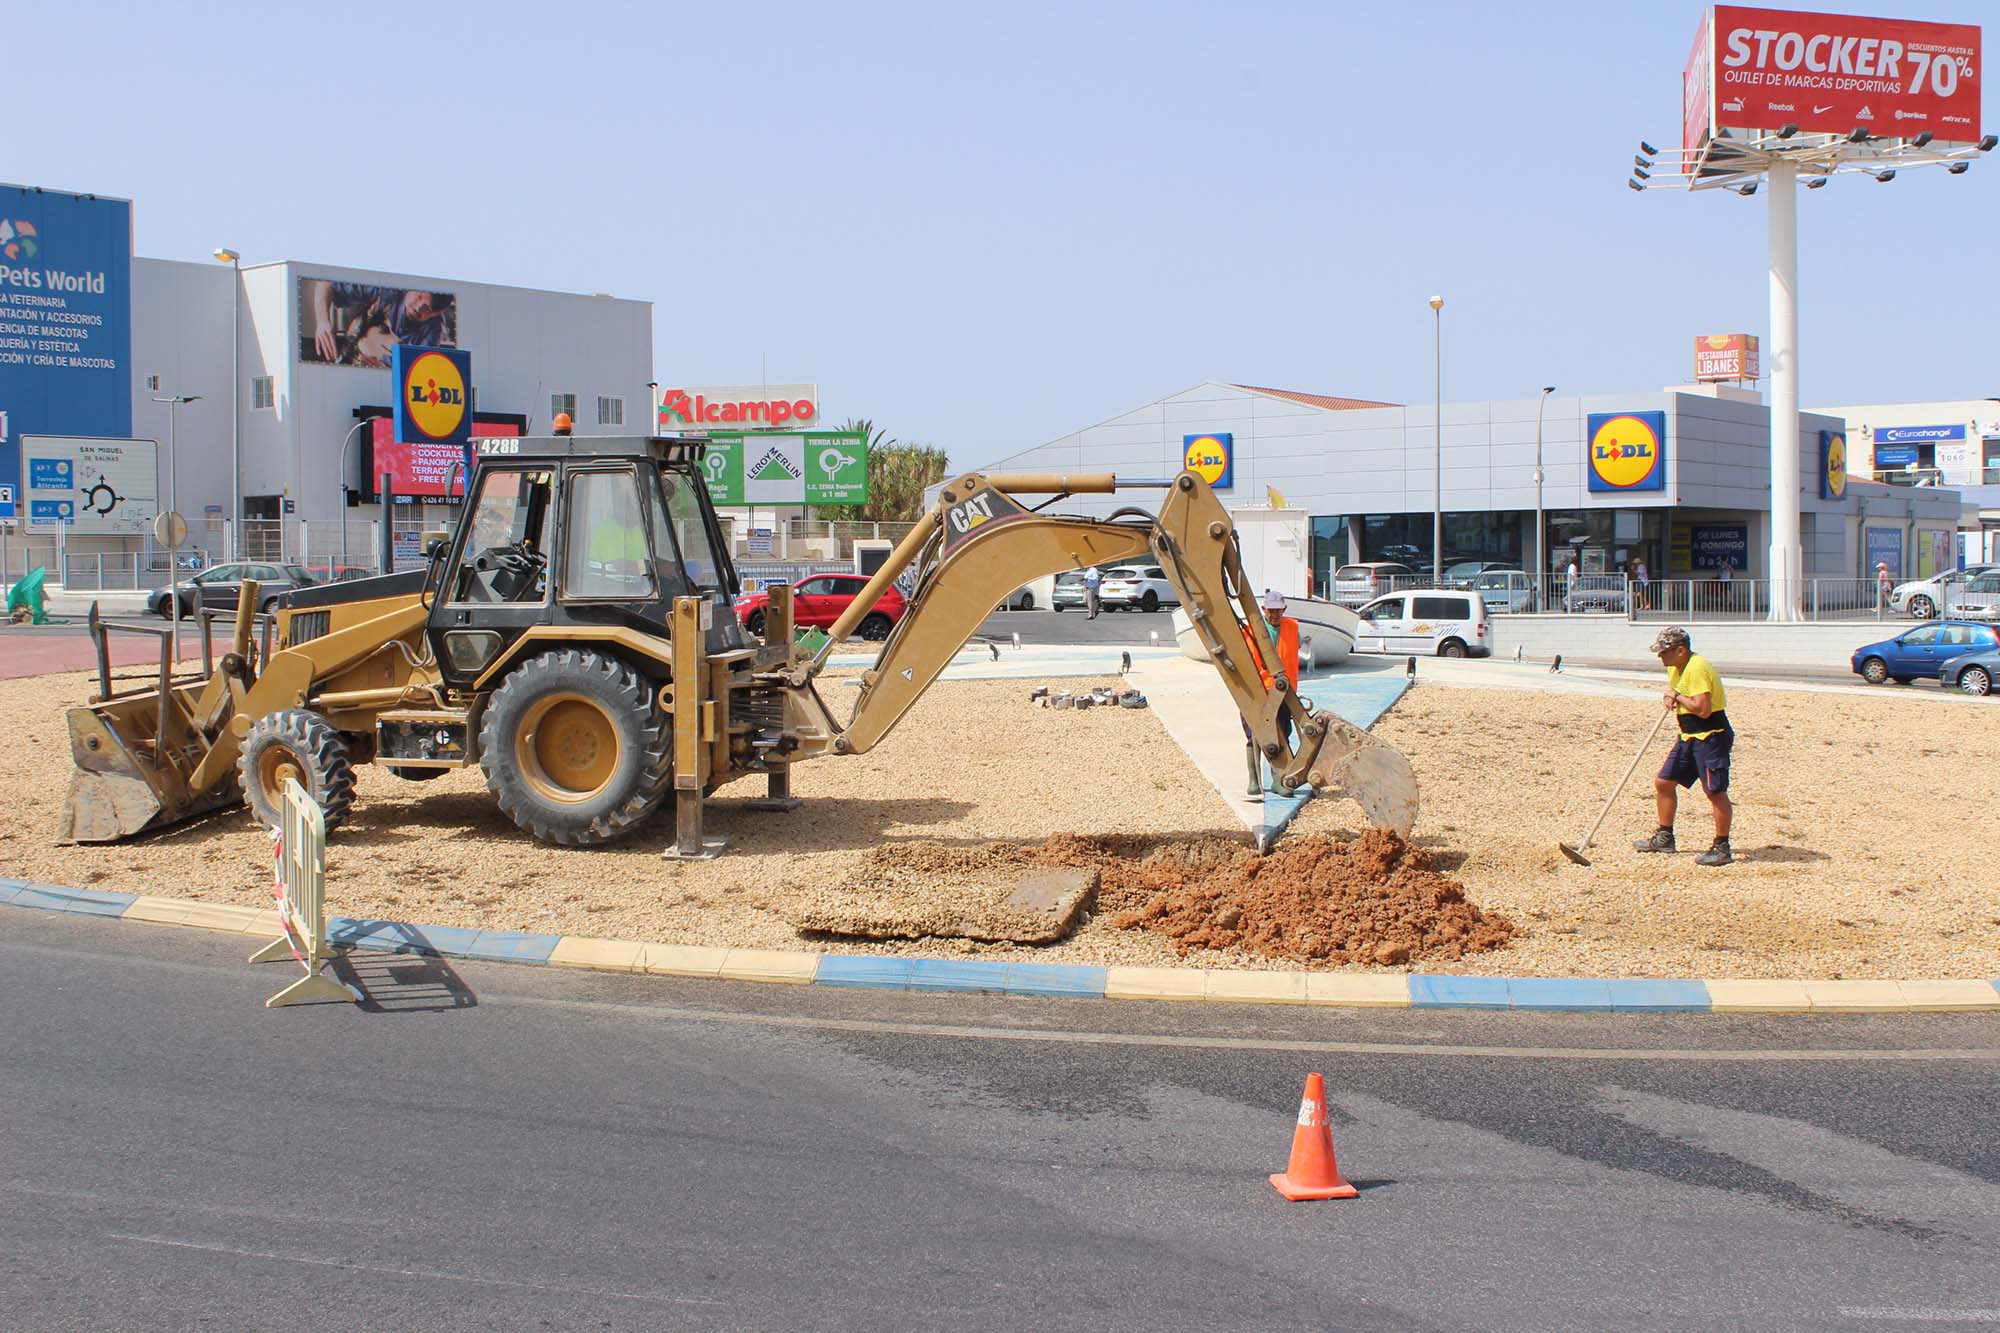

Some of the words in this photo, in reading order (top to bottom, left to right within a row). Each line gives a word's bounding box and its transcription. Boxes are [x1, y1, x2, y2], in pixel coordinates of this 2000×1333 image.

[1722, 28, 1903, 78] STOCKER
[1907, 43, 1946, 53] DESCUENTOS
[1947, 46, 1966, 55] HASTA
[1724, 70, 1762, 85] OUTLET
[1766, 73, 1782, 86] DE
[1784, 74, 1833, 90] MARCAS
[1835, 78, 1902, 95] DEPORTIVAS
[0, 264, 42, 289] Pets
[45, 269, 105, 294] World
[9, 293, 67, 309] VETERINARIA
[39, 311, 46, 321] Y
[47, 312, 103, 326] ACCESORIOS
[28, 325, 39, 336] DE
[41, 327, 89, 339] MASCOTAS
[30, 340, 37, 350] Y
[39, 339, 80, 352] ESTÉTICA
[25, 354, 32, 364] Y
[33, 353, 55, 366] CRÍA
[56, 357, 68, 367] DE
[69, 357, 116, 369] MASCOTAS
[1697, 349, 1740, 360] RESTAURANTE
[1697, 359, 1740, 374] LIBANES
[411, 378, 463, 407] LIDL
[658, 389, 815, 426] Alcampo
[480, 438, 519, 454] 428B
[807, 438, 831, 446] TIENDA
[832, 438, 841, 446] LA
[1595, 438, 1652, 462] LIDL
[418, 449, 464, 458] COCKTAILS
[1188, 452, 1223, 468] LIDL
[747, 454, 773, 479] LEROY
[769, 446, 803, 479] MERLIN
[418, 475, 440, 484] FREE
[950, 492, 994, 533] CAT
[1700, 541, 1745, 550] DOMINGO
